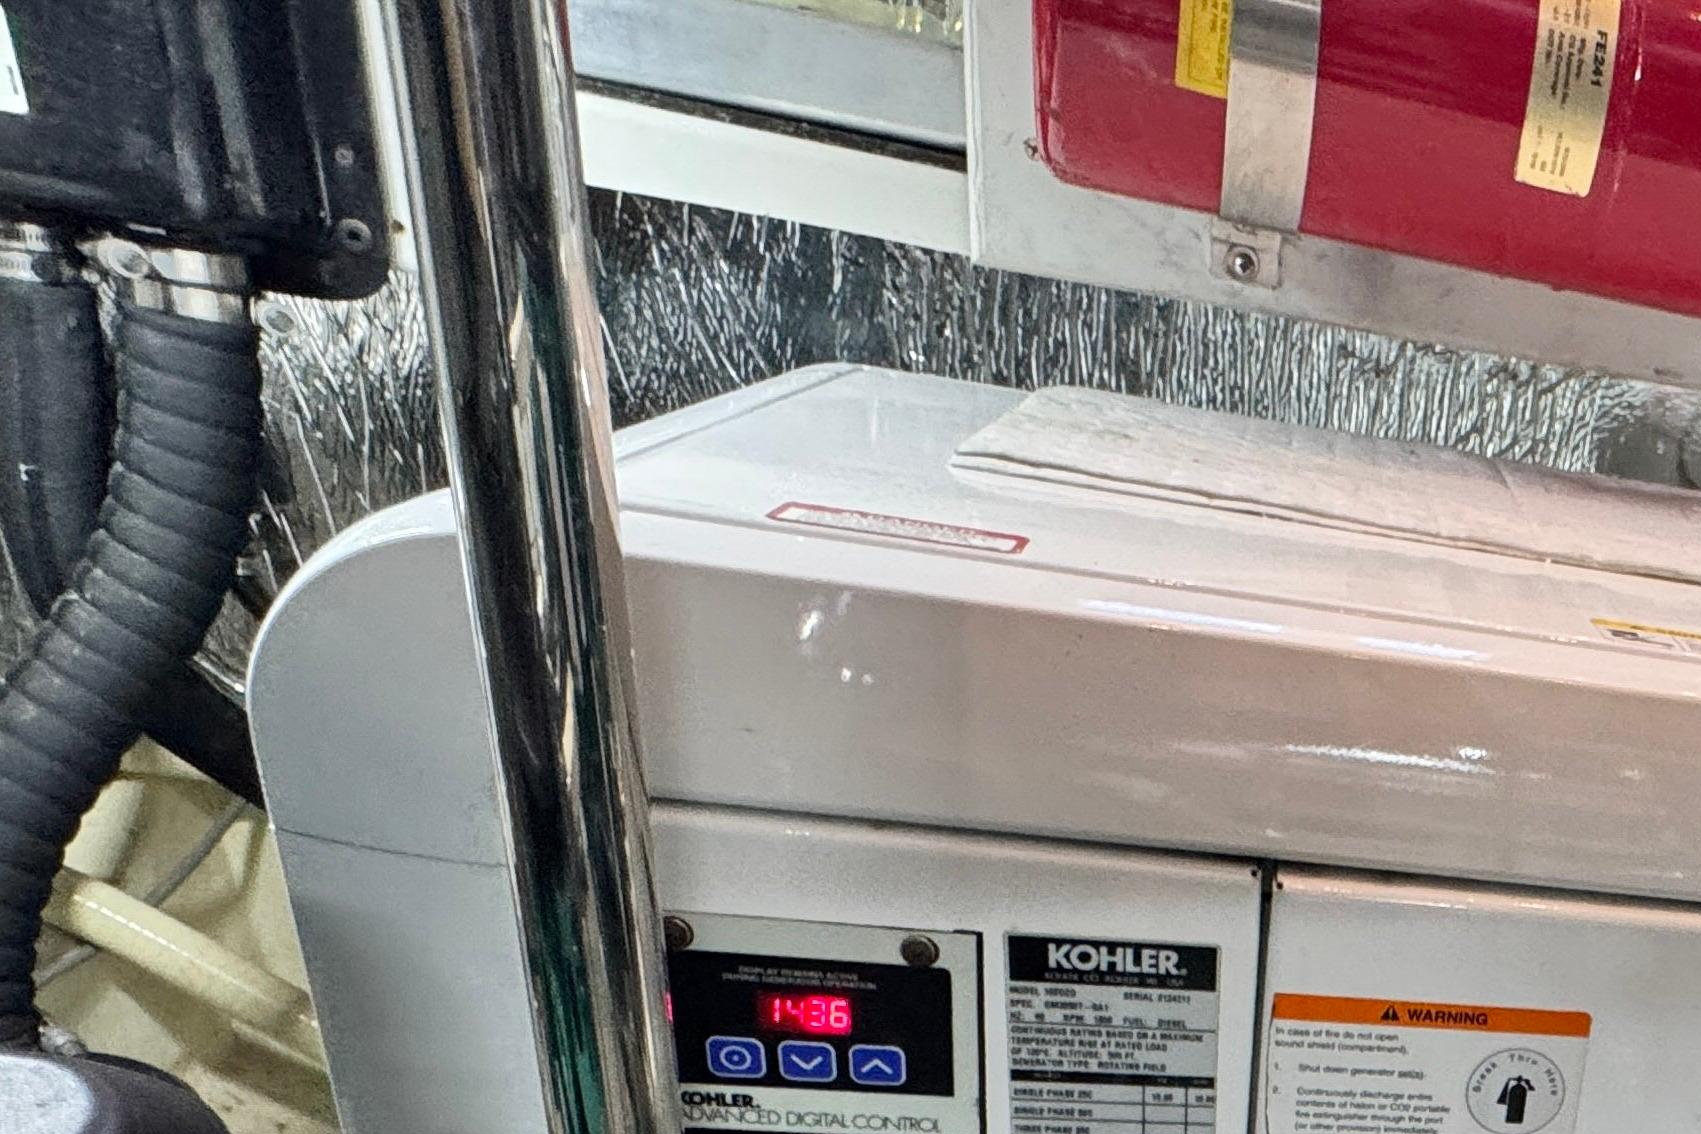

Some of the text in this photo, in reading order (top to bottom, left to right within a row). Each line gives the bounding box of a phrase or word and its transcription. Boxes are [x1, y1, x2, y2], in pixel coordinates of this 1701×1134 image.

[1591, 30, 1607, 86] FE241
[772, 997, 848, 1028] 1436
[1408, 1009, 1489, 1027] WARNING
[1276, 1027, 1399, 1042] In case of fire do not open
[1146, 1043, 1167, 1052] LOAD
[1307, 1041, 1336, 1050] shield
[1299, 1064, 1320, 1073] Shut
[1323, 1065, 1348, 1073] down
[1351, 1067, 1395, 1077] generator
[1509, 1054, 1538, 1065] Thru
[1545, 1068, 1558, 1096] Here
[1297, 1086, 1358, 1100] Continuously
[1360, 1090, 1405, 1102] discharge
[1413, 1104, 1450, 1114] portable
[786, 1112, 848, 1128] DIGITAL
[850, 1114, 942, 1134] CONTROL
[1313, 1111, 1368, 1122] extinguisher
[1371, 1112, 1405, 1125] through
[1408, 1114, 1422, 1123] the
[1425, 1116, 1443, 1125] port
